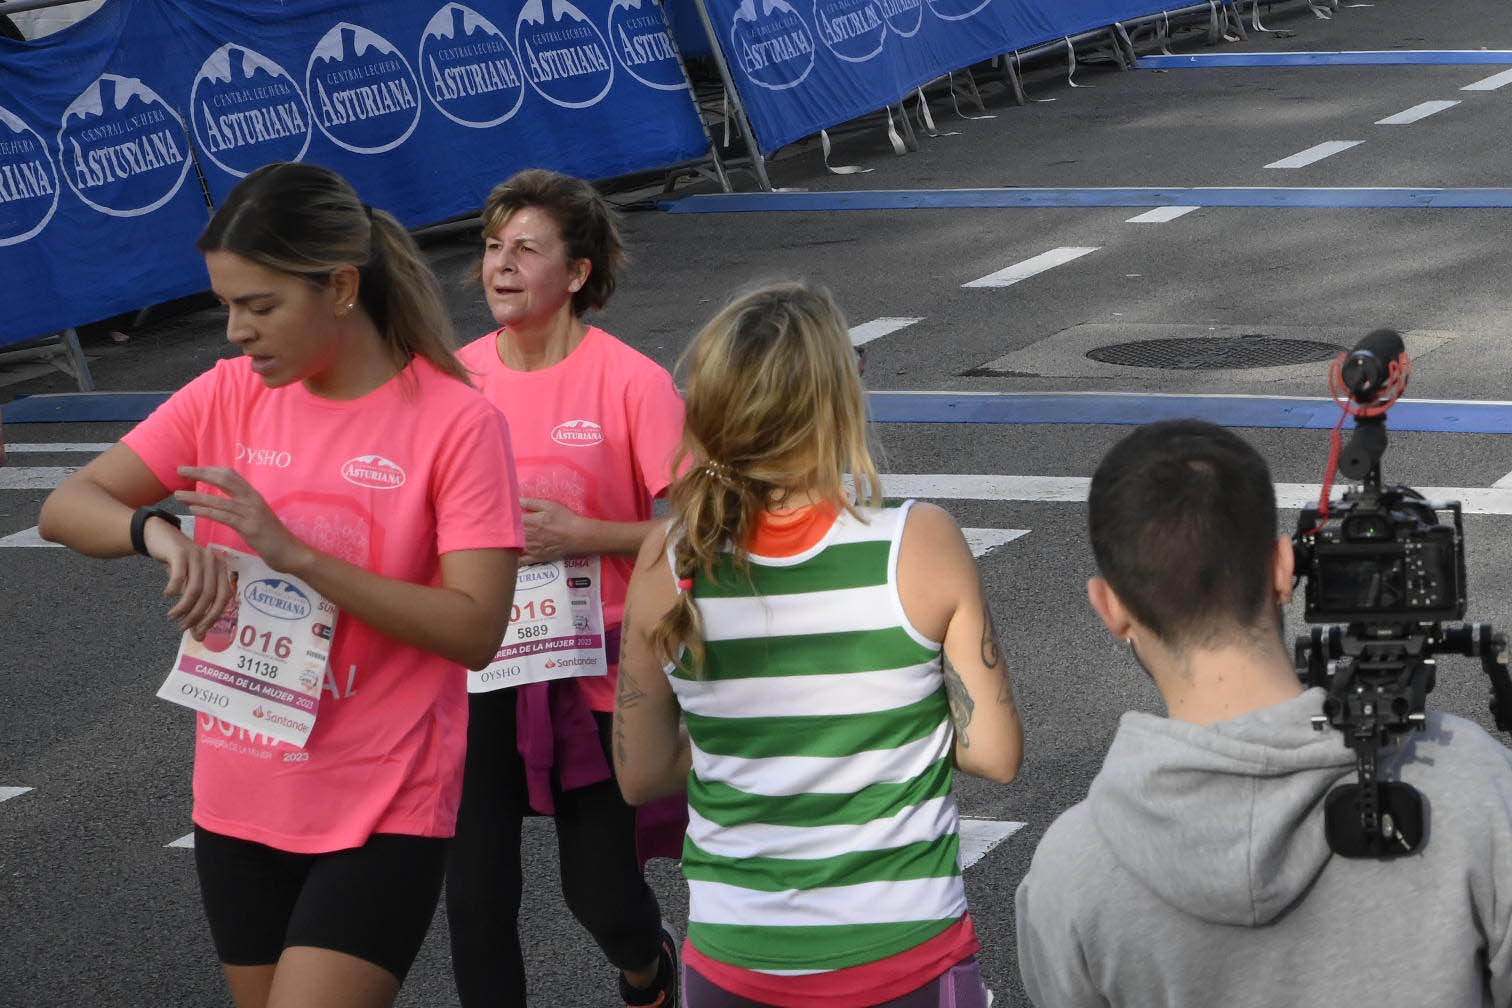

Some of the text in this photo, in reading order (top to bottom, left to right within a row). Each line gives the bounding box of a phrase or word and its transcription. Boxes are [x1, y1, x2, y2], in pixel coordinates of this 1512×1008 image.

[525, 38, 609, 83] ASTURIANA
[429, 53, 521, 102] ASTURIANA
[316, 77, 417, 128] ASTURIANA
[202, 99, 306, 153] ASTURIANA
[69, 129, 183, 189] ASTURIANA
[556, 429, 602, 441] ASTURIANA
[345, 465, 401, 485] ASTURIANA
[251, 586, 305, 616] ASTURIANA
[509, 598, 557, 623] 016
[239, 625, 293, 659] 016
[518, 624, 548, 639] 5889
[519, 645, 531, 654] DE
[532, 643, 543, 651] LA
[545, 639, 575, 649] MUJER
[237, 655, 278, 679] 31138
[481, 665, 521, 683] OYSHO
[557, 657, 597, 668] Santander
[181, 683, 230, 709] OYSHO
[195, 664, 314, 710] CARRERA DE LA MUJER 2023
[283, 751, 310, 763] 2023
